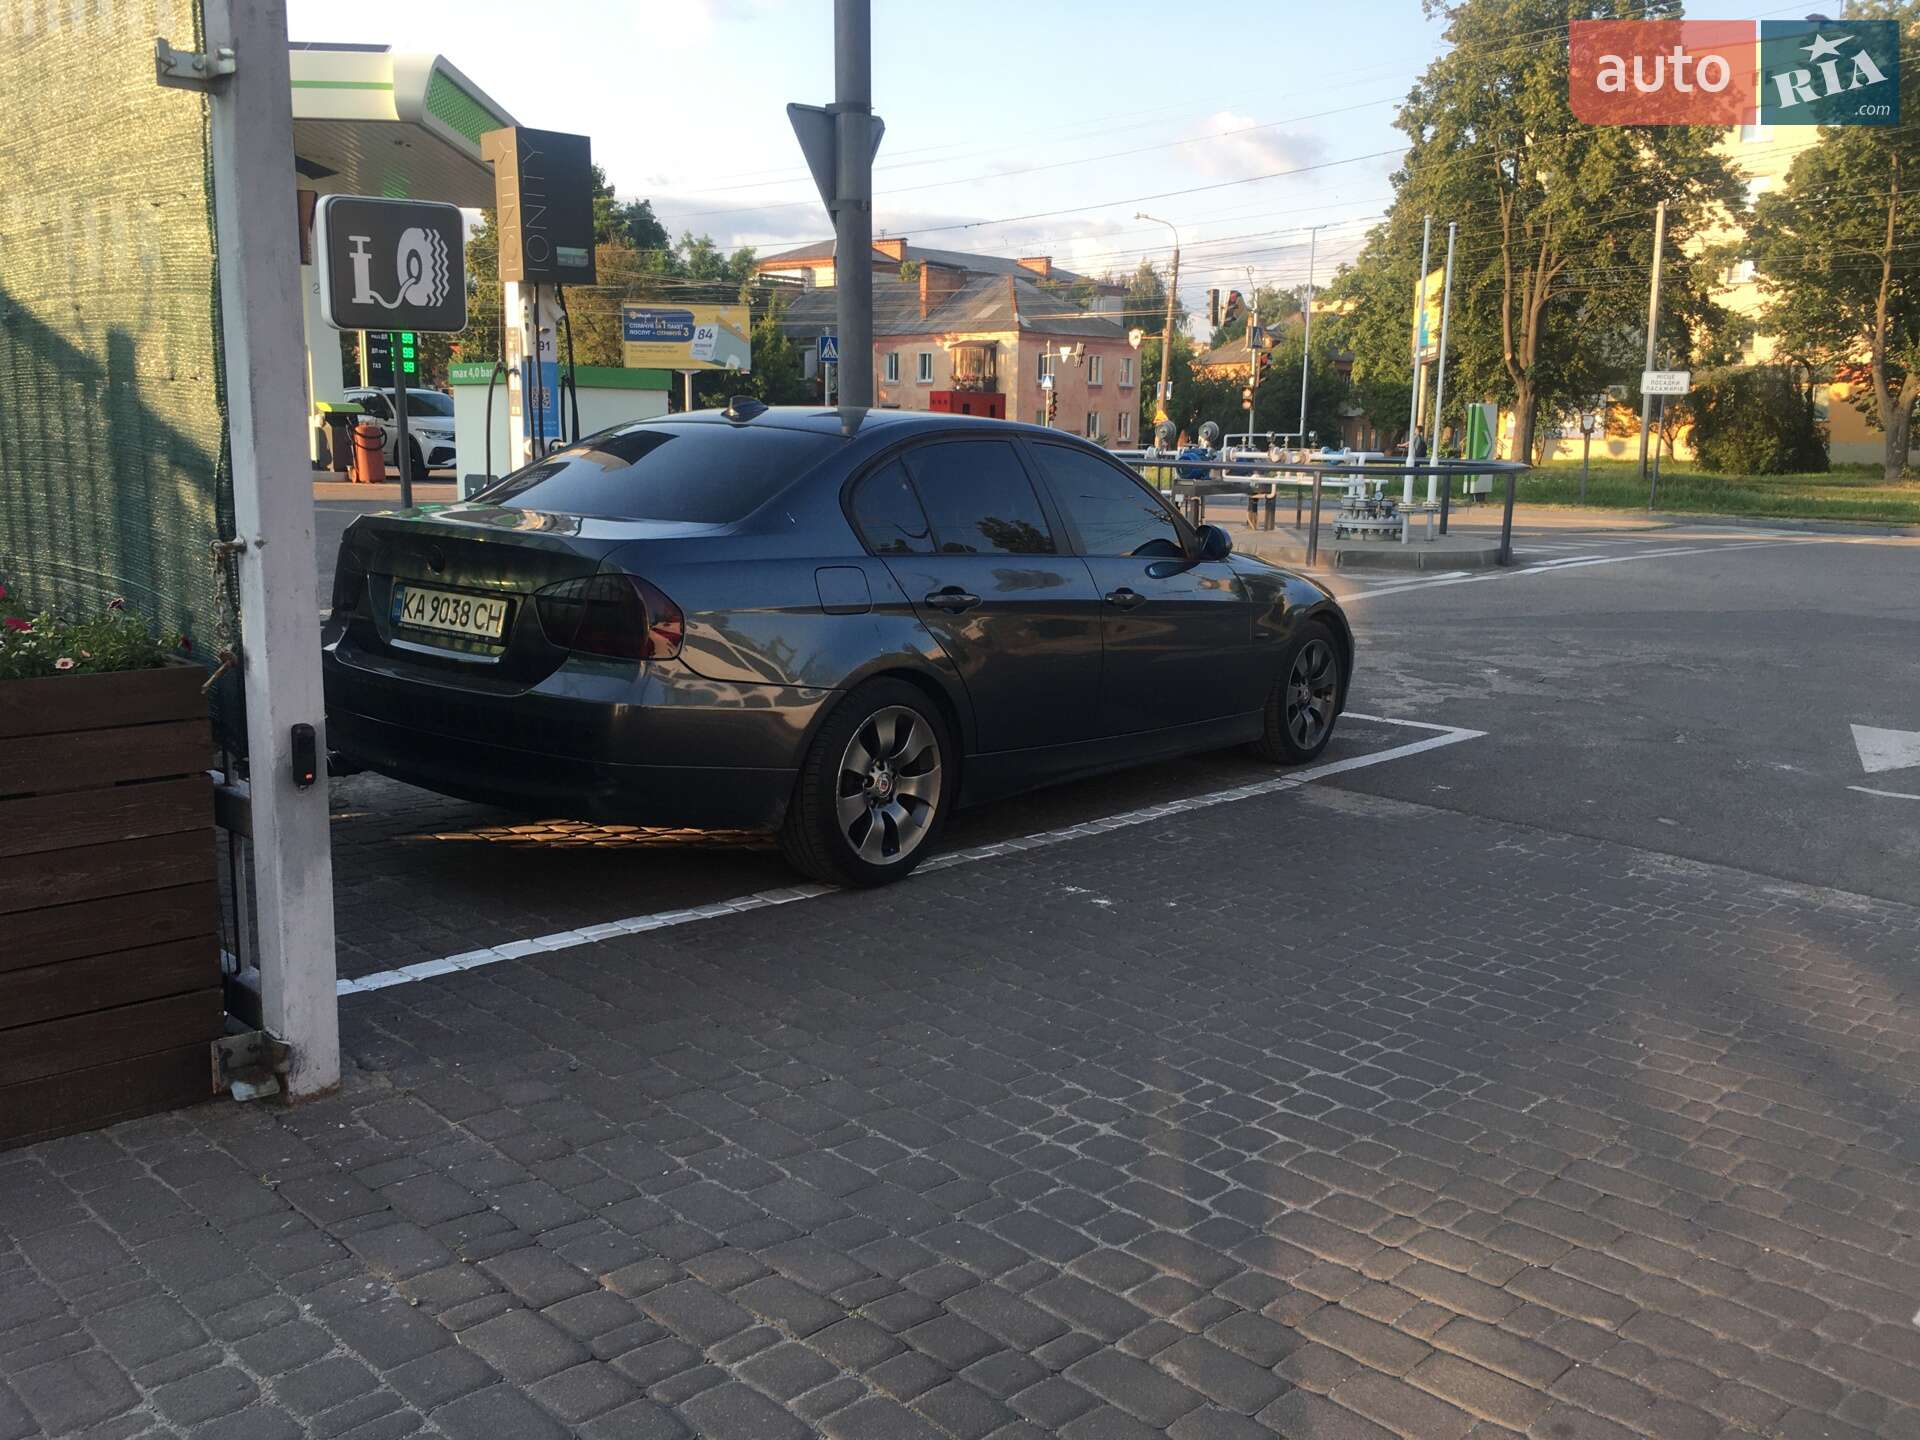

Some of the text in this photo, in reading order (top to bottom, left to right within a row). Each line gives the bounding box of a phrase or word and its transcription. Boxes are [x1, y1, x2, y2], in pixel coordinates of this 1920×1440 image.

[498, 140, 520, 272] IONITY
[520, 137, 551, 272] IONITY
[683, 327, 689, 337] 3
[698, 328, 714, 340] 84
[452, 369, 467, 378] max
[468, 367, 479, 380] 4,0
